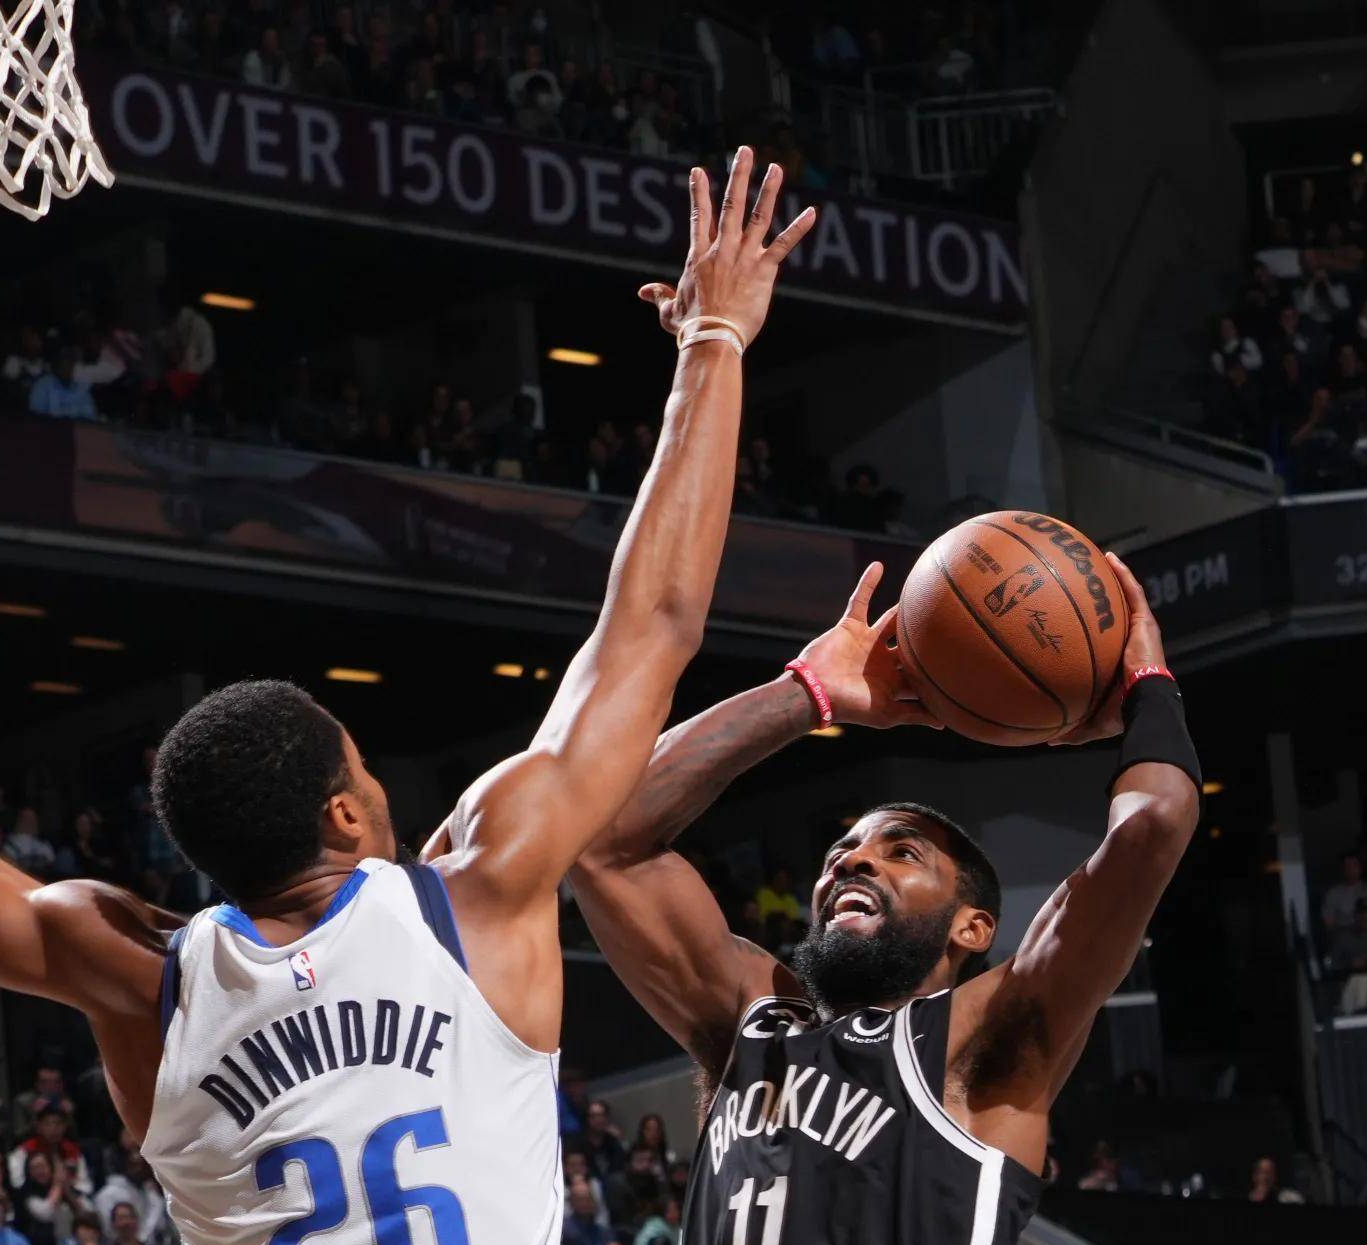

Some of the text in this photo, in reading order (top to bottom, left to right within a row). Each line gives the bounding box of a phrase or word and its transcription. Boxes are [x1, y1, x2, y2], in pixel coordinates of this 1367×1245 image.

[111, 73, 344, 190] OVER
[369, 120, 496, 214] 150
[1184, 552, 1230, 597] PM
[198, 999, 452, 1130] DINWIDDIE
